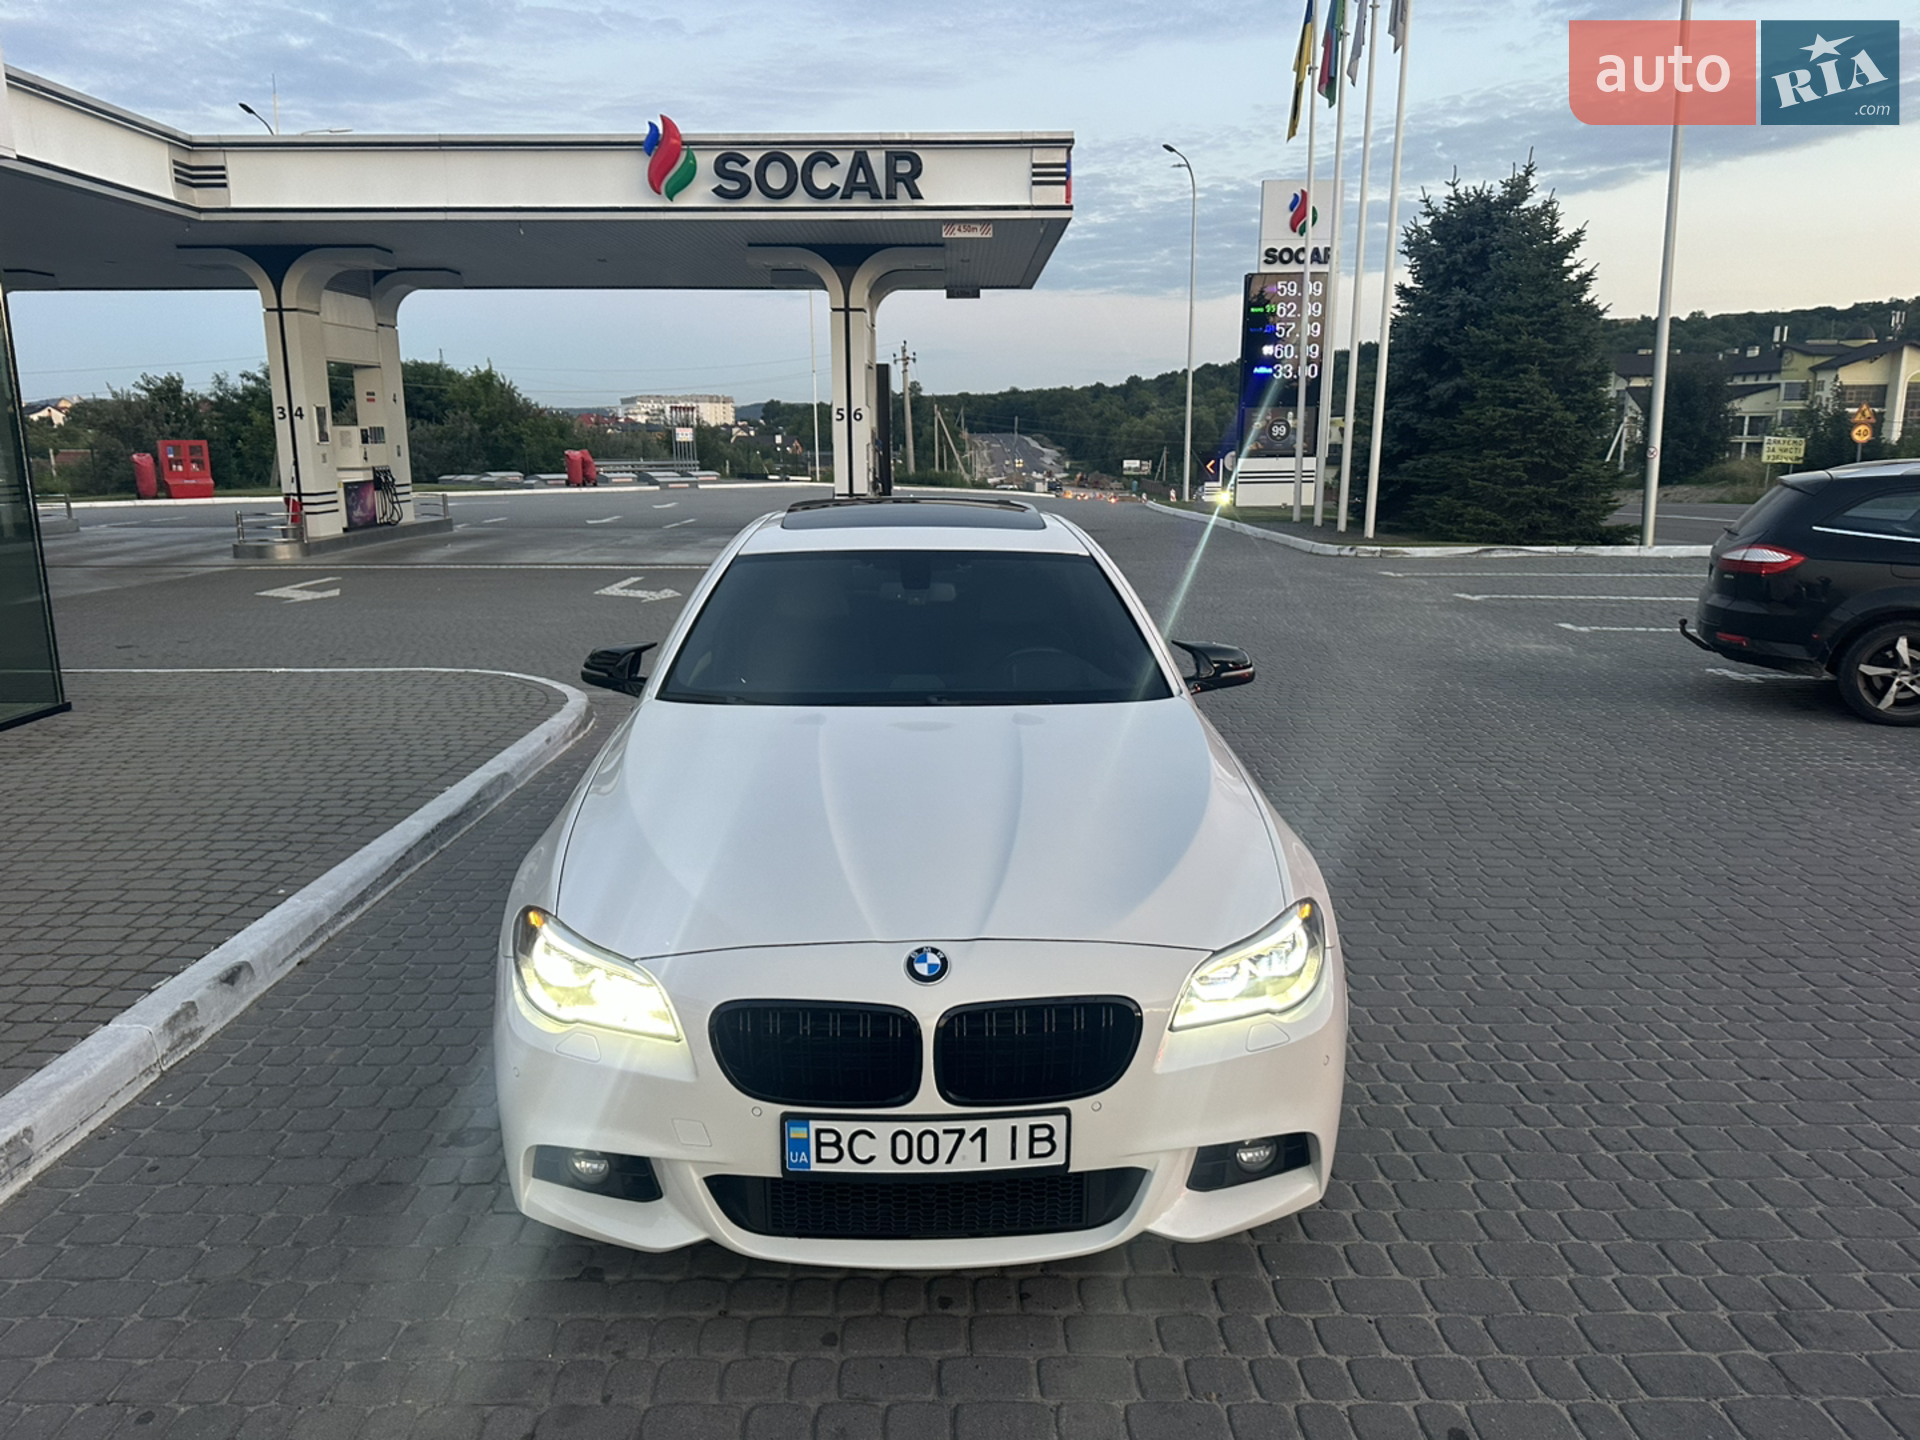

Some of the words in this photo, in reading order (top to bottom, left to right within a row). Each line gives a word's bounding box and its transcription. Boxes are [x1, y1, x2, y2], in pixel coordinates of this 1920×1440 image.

[711, 150, 925, 200] SOCAR
[957, 224, 978, 233] 4.50m
[1275, 322, 1321, 338] 57.9
[1274, 344, 1320, 359] 60.9
[276, 406, 287, 420] 3
[294, 406, 305, 420] 4
[835, 408, 845, 421] 5
[853, 408, 863, 421] 6
[1271, 424, 1287, 436] 99
[1855, 428, 1869, 437] 40
[790, 1151, 809, 1164] UA
[814, 1127, 877, 1165] BC
[890, 1126, 988, 1165] 0071
[1010, 1123, 1057, 1161] IB
